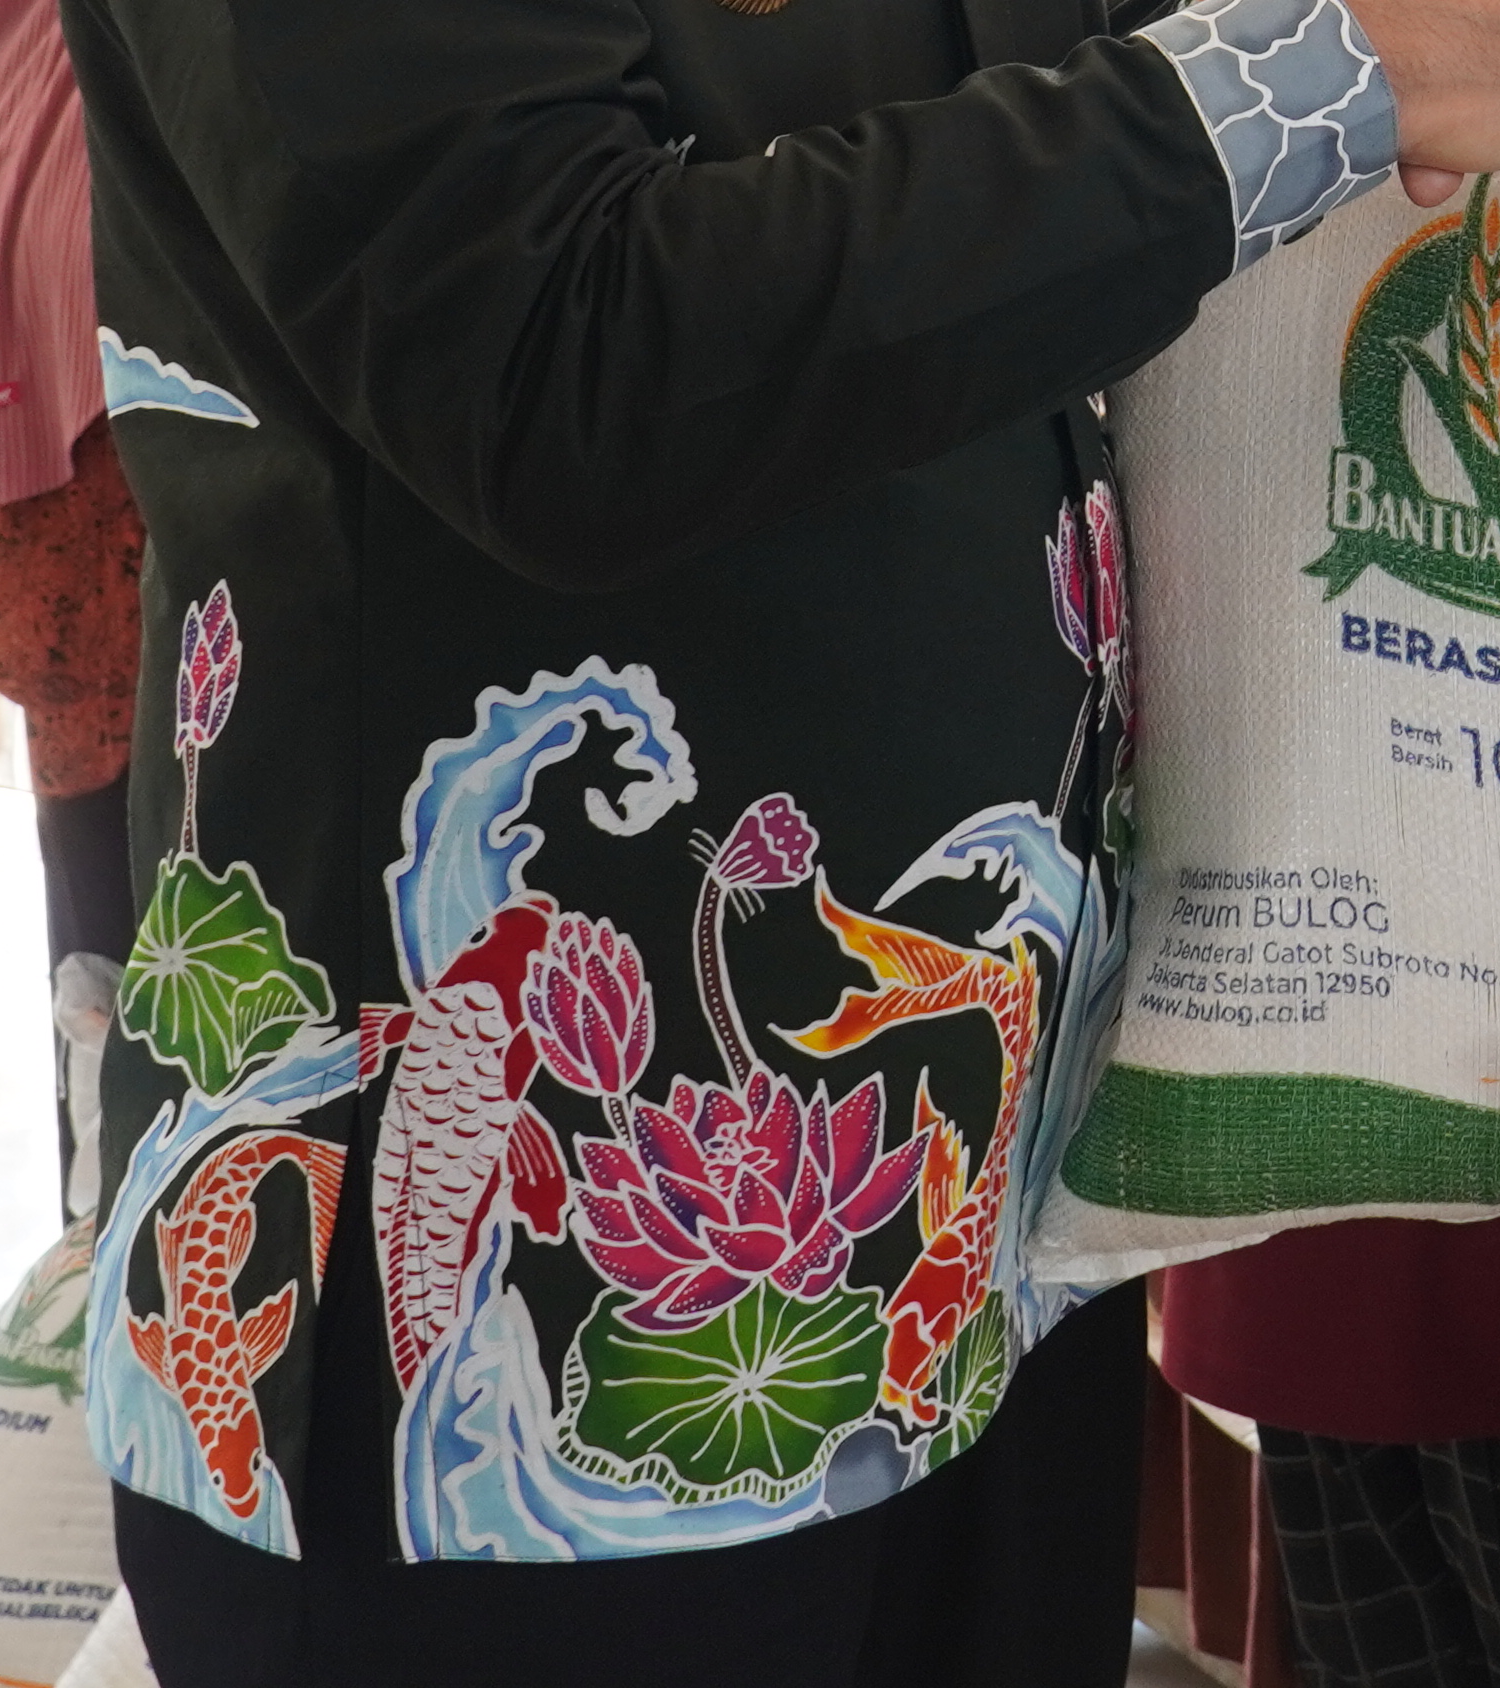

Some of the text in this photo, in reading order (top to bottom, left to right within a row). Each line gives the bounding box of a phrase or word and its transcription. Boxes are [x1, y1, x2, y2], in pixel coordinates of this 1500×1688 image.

[1390, 717, 1443, 746] Berat
[1390, 744, 1453, 773] Bersih
[1310, 866, 1379, 895] Oleh:
[1169, 896, 1390, 934] Perum BULOG
[1342, 942, 1450, 980] Subroto
[1146, 962, 1391, 998] Jakarta Selatan 12950
[1137, 989, 1327, 1027] www.bulog.co.id
